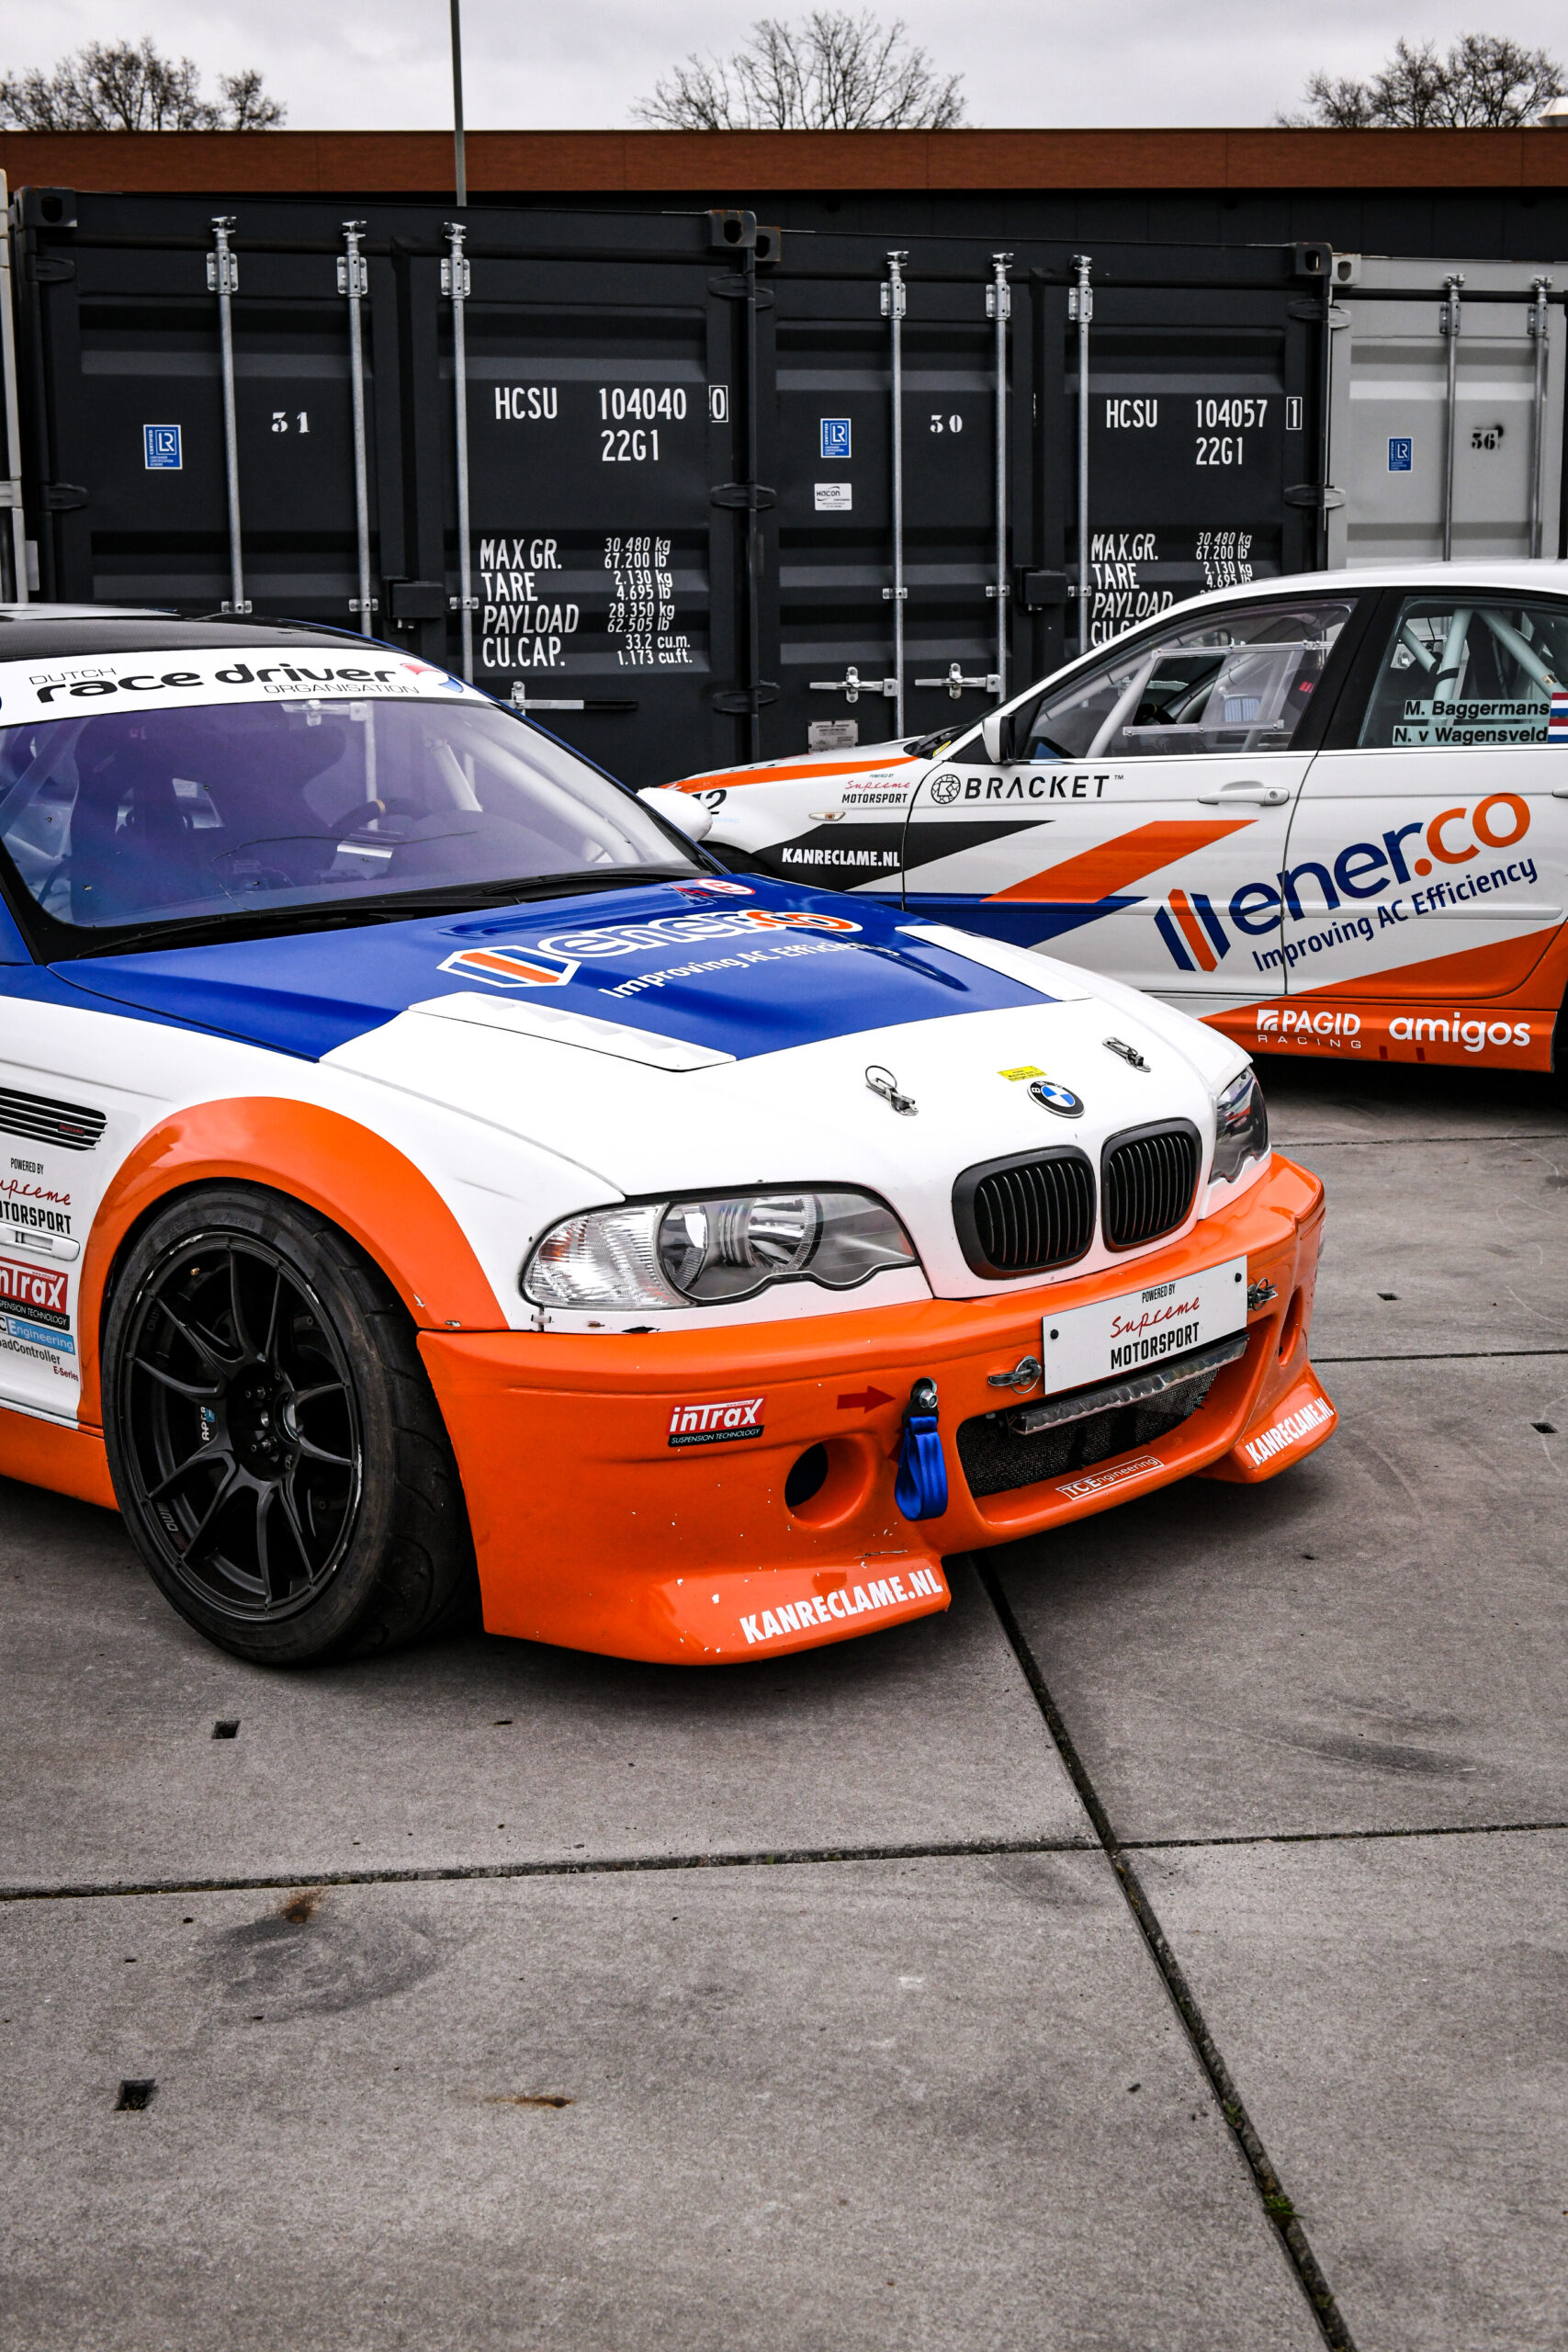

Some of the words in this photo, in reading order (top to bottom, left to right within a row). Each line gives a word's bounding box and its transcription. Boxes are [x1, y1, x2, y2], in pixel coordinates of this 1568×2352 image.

[494, 387, 558, 420] HCSU
[599, 388, 687, 420] 104040
[712, 388, 726, 420] 0
[1106, 399, 1157, 428] HCSU
[1196, 399, 1268, 428] 104057
[272, 412, 310, 433] 31
[832, 425, 846, 443] LR
[930, 414, 963, 433] 30
[158, 432, 175, 452] LR
[601, 429, 659, 461] 22G1
[1196, 436, 1243, 466] 22G1
[1397, 443, 1408, 458] LR
[479, 538, 525, 570] MAX
[530, 538, 562, 570] GR.
[604, 537, 650, 552] 30.480
[655, 537, 671, 555] kg
[1090, 533, 1158, 561] MAX.GR.
[1196, 532, 1235, 546] 30.480
[1238, 532, 1252, 548] kg
[1196, 546, 1234, 560] 67.200
[1237, 545, 1247, 559] lb
[604, 552, 650, 569] 67.200
[655, 551, 667, 568] lb
[480, 571, 538, 602] TARE
[613, 570, 652, 584] 2.130
[655, 570, 672, 587] kg
[1092, 563, 1140, 590] TARE
[1203, 561, 1235, 575] 2.130
[1239, 561, 1253, 577] kg
[1206, 573, 1237, 588] 4.695
[616, 584, 654, 600] 4.695
[658, 584, 671, 599] lb
[1091, 591, 1174, 618] PAYLOAD
[482, 605, 580, 634] PAYLOAD
[609, 602, 655, 618] 28.350
[660, 602, 675, 620] kg
[607, 617, 653, 632] 62.505
[657, 617, 670, 631] lb
[482, 637, 566, 667] CU.CAP.
[626, 634, 652, 650] 33.2
[657, 635, 691, 648] cu.m.
[617, 650, 654, 665] 1.173
[659, 649, 693, 663] cu.ft.
[28, 668, 118, 685] DUTCH
[37, 672, 205, 704] race
[215, 663, 397, 684] driver
[264, 684, 421, 695] ORGANISATION
[1404, 701, 1426, 715] M.
[1432, 700, 1550, 718] Baggermans
[1394, 727, 1412, 741] N.
[1418, 730, 1429, 741] v
[1435, 727, 1549, 745] Wagensveld
[841, 793, 908, 804] MOTORSPORT
[844, 780, 910, 792] Supreme
[964, 775, 1110, 799] BRACKET
[782, 847, 900, 867] KANRECLAME.NL
[1228, 792, 1531, 935] ener.co
[1252, 917, 1374, 972] Improving
[1377, 899, 1409, 929] AC
[1412, 858, 1539, 916] Efficiency
[598, 958, 750, 999] Improving
[737, 946, 781, 963] AC
[1281, 1010, 1361, 1036] PAGID
[1388, 1012, 1531, 1053] amigos
[1258, 1035, 1362, 1049] RACING
[10, 1158, 36, 1173] POWERED
[37, 1163, 44, 1175] BY
[0, 1179, 72, 1205] upreme
[0, 1200, 73, 1234] TORSPORT
[0, 1260, 65, 1309] nTrax
[1142, 1286, 1168, 1304] POWERED
[1168, 1283, 1176, 1295] BY
[0, 1299, 27, 1314] PENSION
[27, 1307, 67, 1326] TECHNOLOGY
[1110, 1296, 1201, 1339] Supreme
[0, 1339, 61, 1364] adController
[1111, 1321, 1200, 1370] MOTORSPORT
[53, 1365, 79, 1382] E-Series
[669, 1397, 764, 1433] inTrax
[671, 1434, 715, 1444] SUSPENSION
[716, 1428, 761, 1441] TECHNOLOGY
[1245, 1396, 1335, 1466] KANRECLAME.NL
[739, 1568, 944, 1645] KANRECLAME.NL
